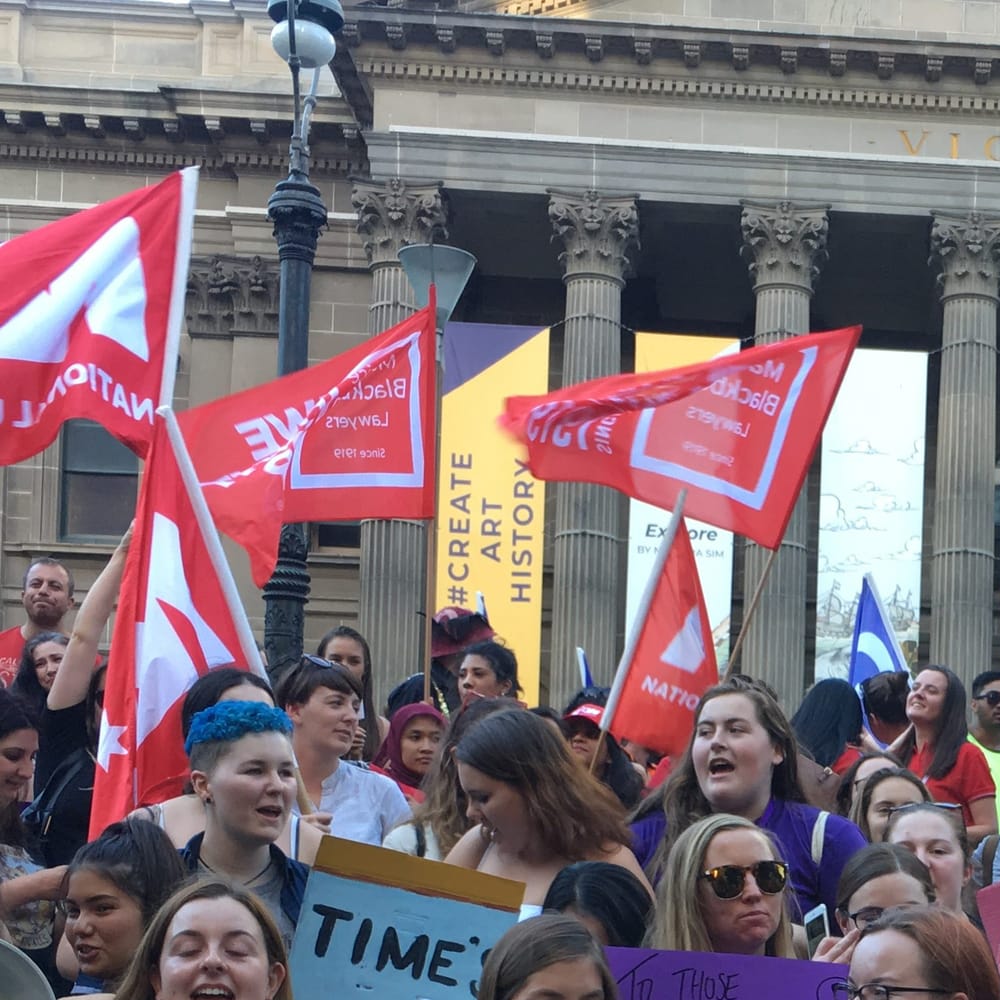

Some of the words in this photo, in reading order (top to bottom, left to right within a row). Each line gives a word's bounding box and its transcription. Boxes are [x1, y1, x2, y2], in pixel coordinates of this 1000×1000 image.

[447, 452, 473, 605] #CREATE
[480, 497, 502, 563] ART
[510, 458, 535, 603] HISTORY
[637, 545, 652, 555] BY
[705, 549, 725, 559] SIM
[645, 523, 718, 542] Exore
[640, 674, 701, 712] NATIO
